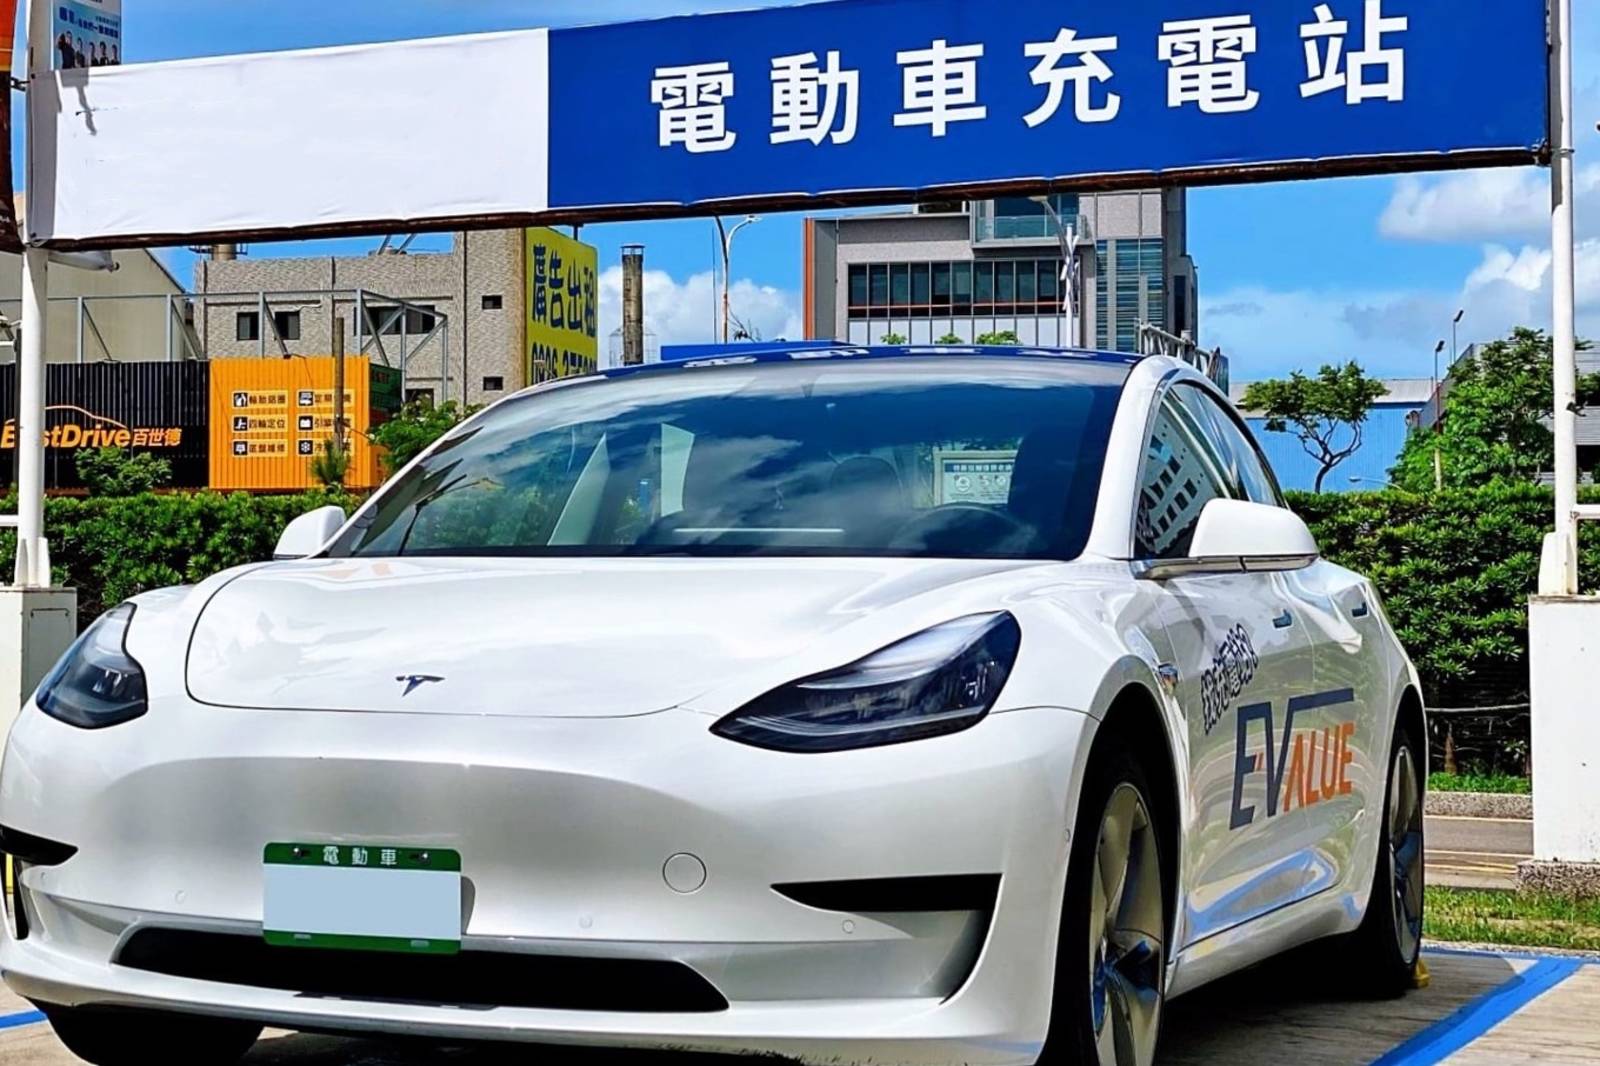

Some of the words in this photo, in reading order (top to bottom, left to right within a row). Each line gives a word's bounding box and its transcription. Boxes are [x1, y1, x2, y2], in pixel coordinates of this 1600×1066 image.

[650, 0, 1409, 154] 電動車充電站
[0, 424, 131, 448] BstDrive
[132, 428, 182, 447] 百世德
[1230, 687, 1355, 831] EVALUE
[323, 845, 397, 866] 電動車
